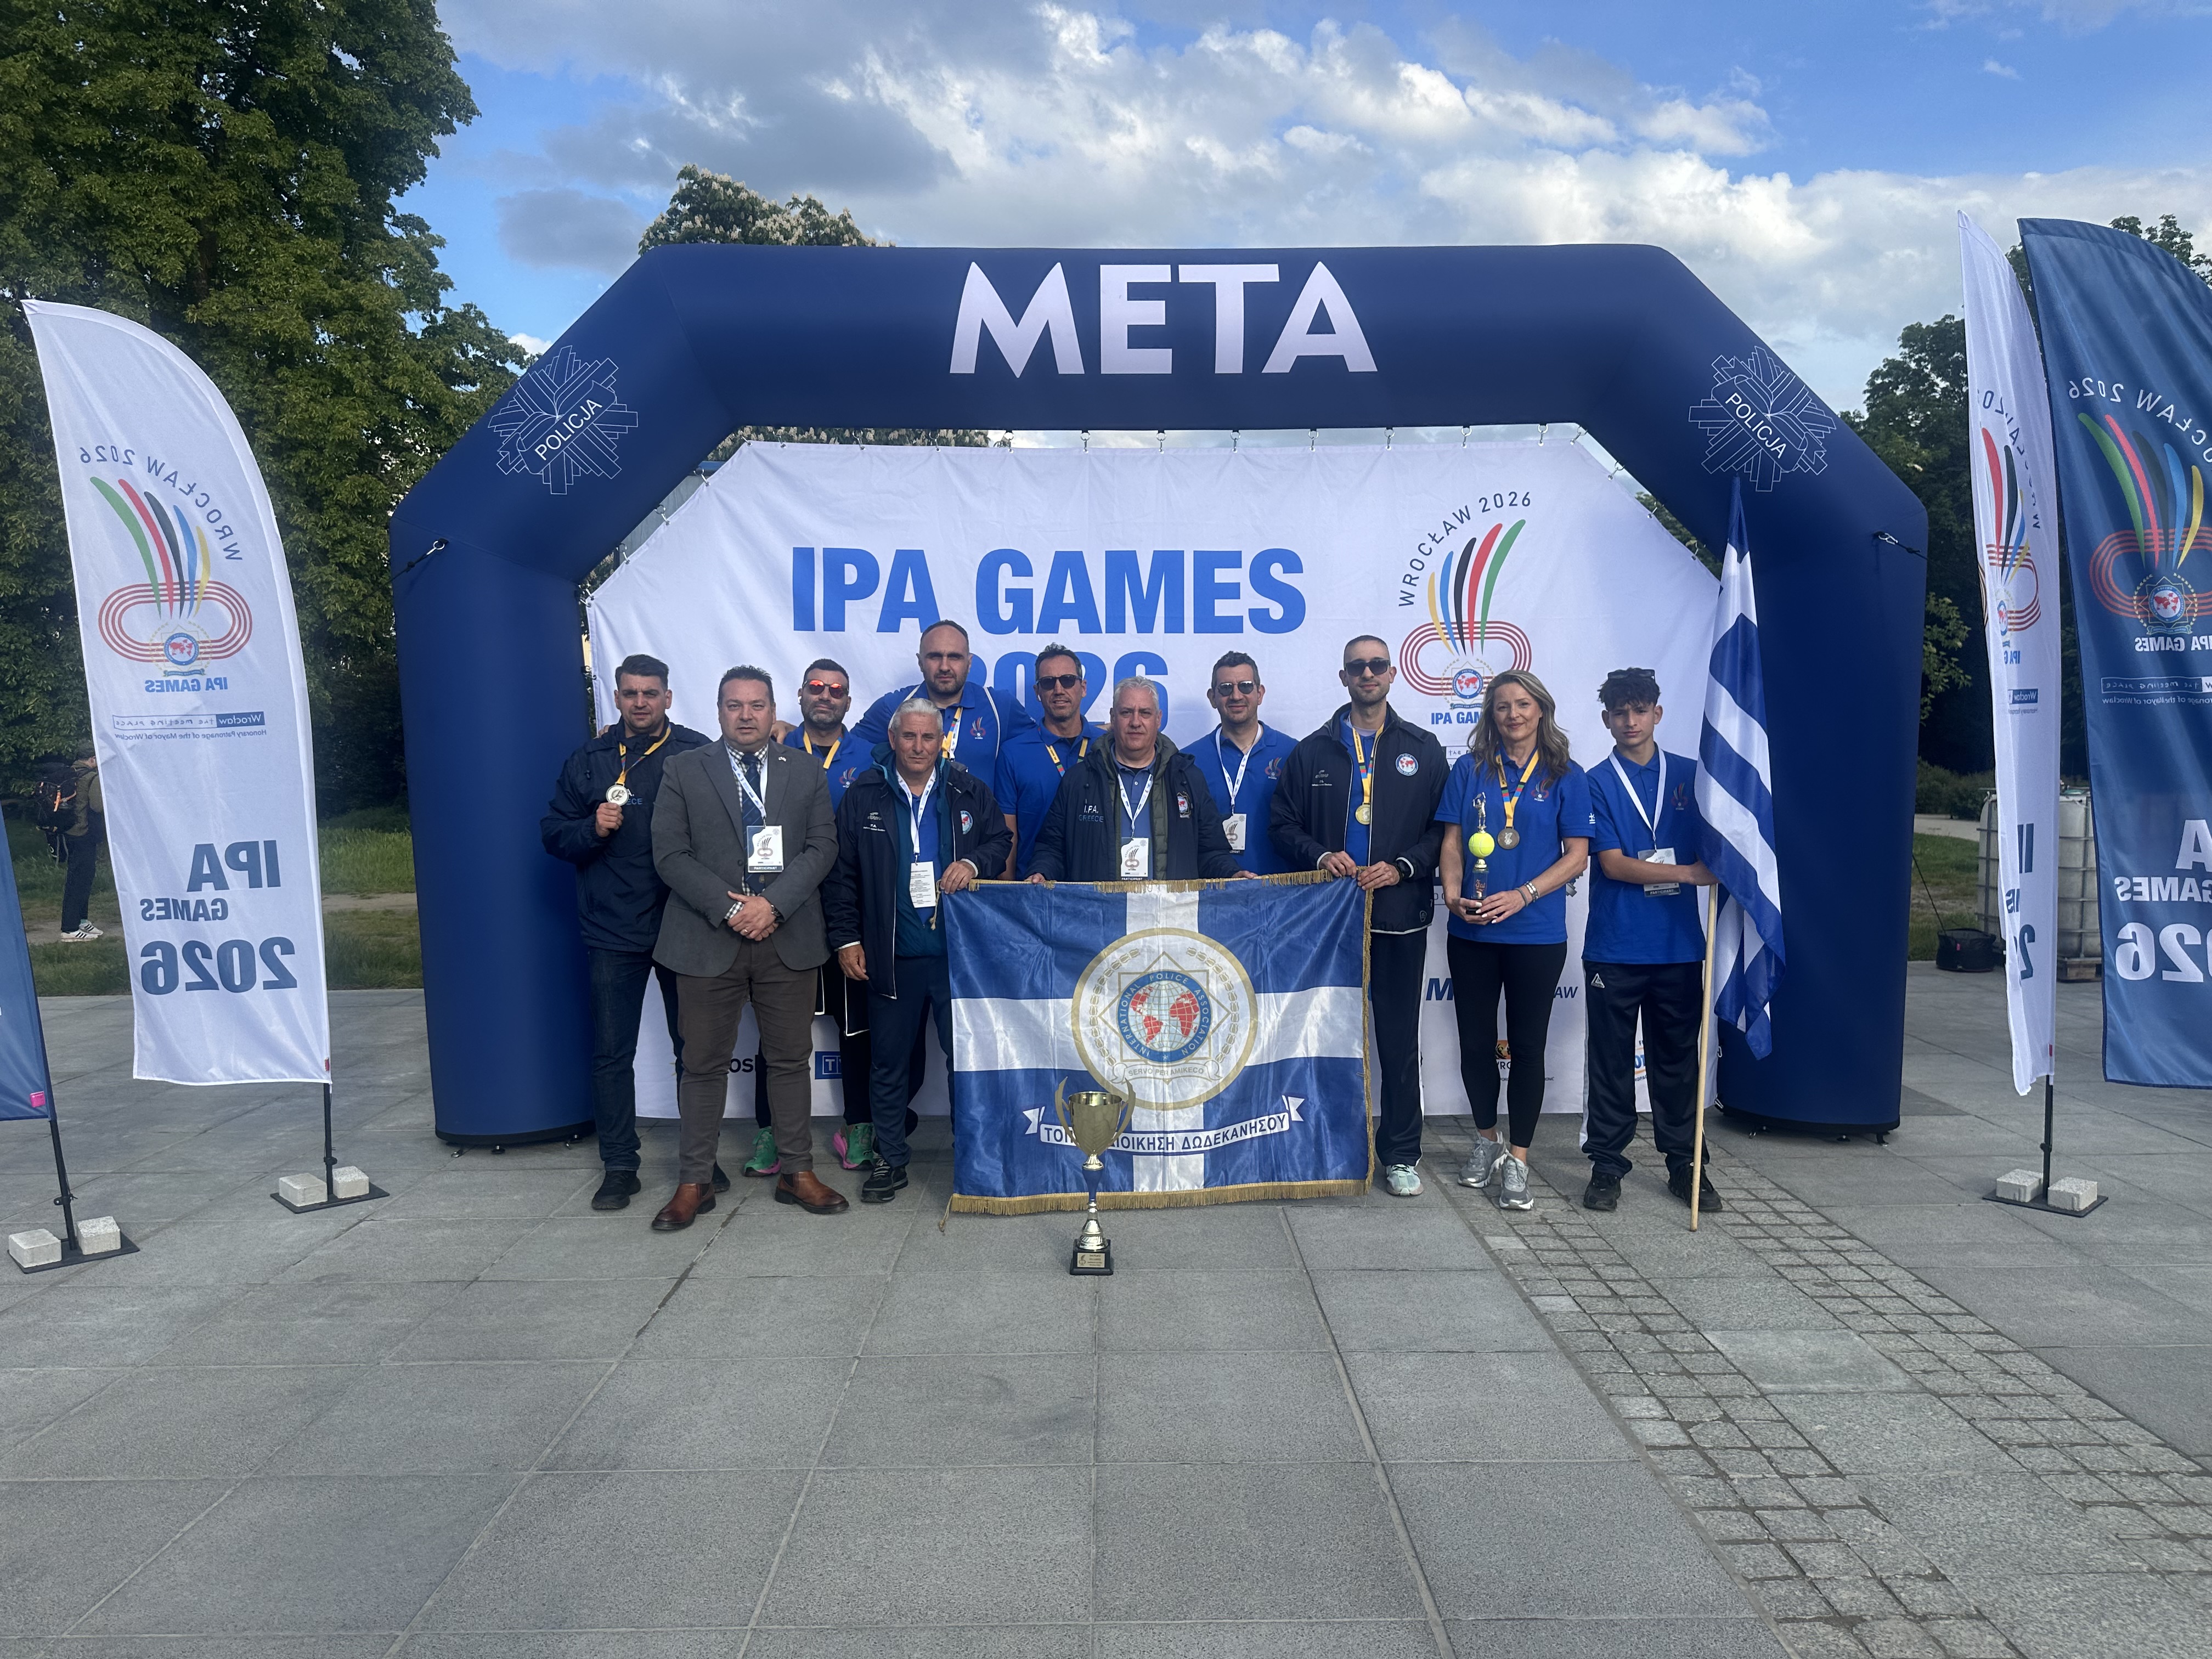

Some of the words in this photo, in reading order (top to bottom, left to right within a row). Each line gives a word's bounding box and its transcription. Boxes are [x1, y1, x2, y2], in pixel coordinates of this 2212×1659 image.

[950, 261, 1378, 378] META
[534, 399, 602, 461] POLICJA
[1725, 392, 1786, 459] POLICJA
[1398, 505, 1471, 607] WROCŁAW
[1479, 492, 1531, 513] 2026
[793, 547, 939, 633] IPA
[976, 548, 1306, 634] GAMES
[1431, 712, 1452, 725] IPA
[1079, 814, 1104, 822] GREECE
[1120, 983, 1150, 1057] INTERNATIONAL
[1149, 973, 1189, 984] POLICE
[1181, 989, 1209, 1056] ASSOCIATION
[1128, 1068, 1153, 1076] SERVO
[1110, 1133, 1175, 1150] ΙΟΙΚΗΣΗ
[1182, 1115, 1286, 1150] ΔΩΔΕΚΑΝΗΣΟΥ
